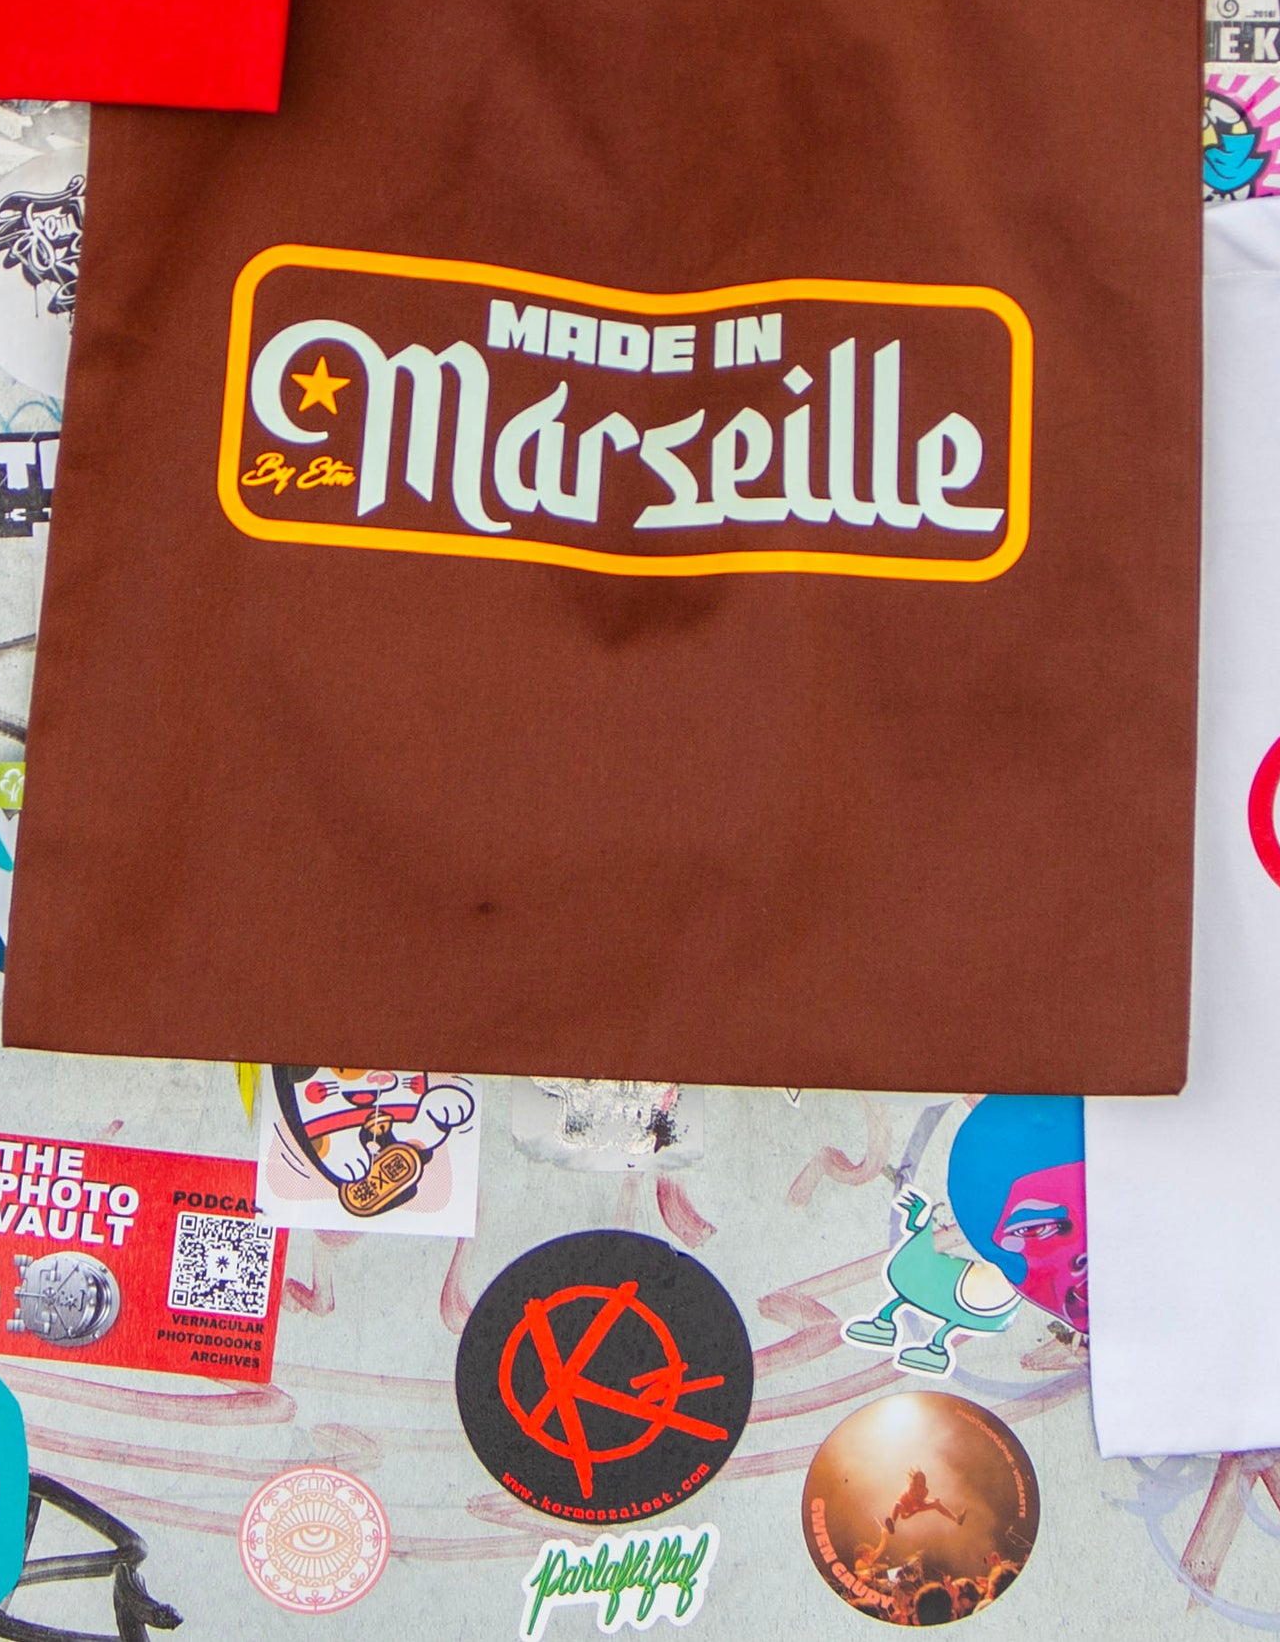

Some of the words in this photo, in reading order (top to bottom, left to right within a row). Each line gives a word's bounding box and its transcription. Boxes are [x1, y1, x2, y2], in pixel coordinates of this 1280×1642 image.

[487, 299, 697, 373] MADE
[714, 312, 783, 369] IN
[251, 319, 1005, 533] Marseille
[241, 453, 295, 494] By
[171, 1313, 264, 1335] VERNACULAR
[190, 1350, 260, 1369] ARCHIVES
